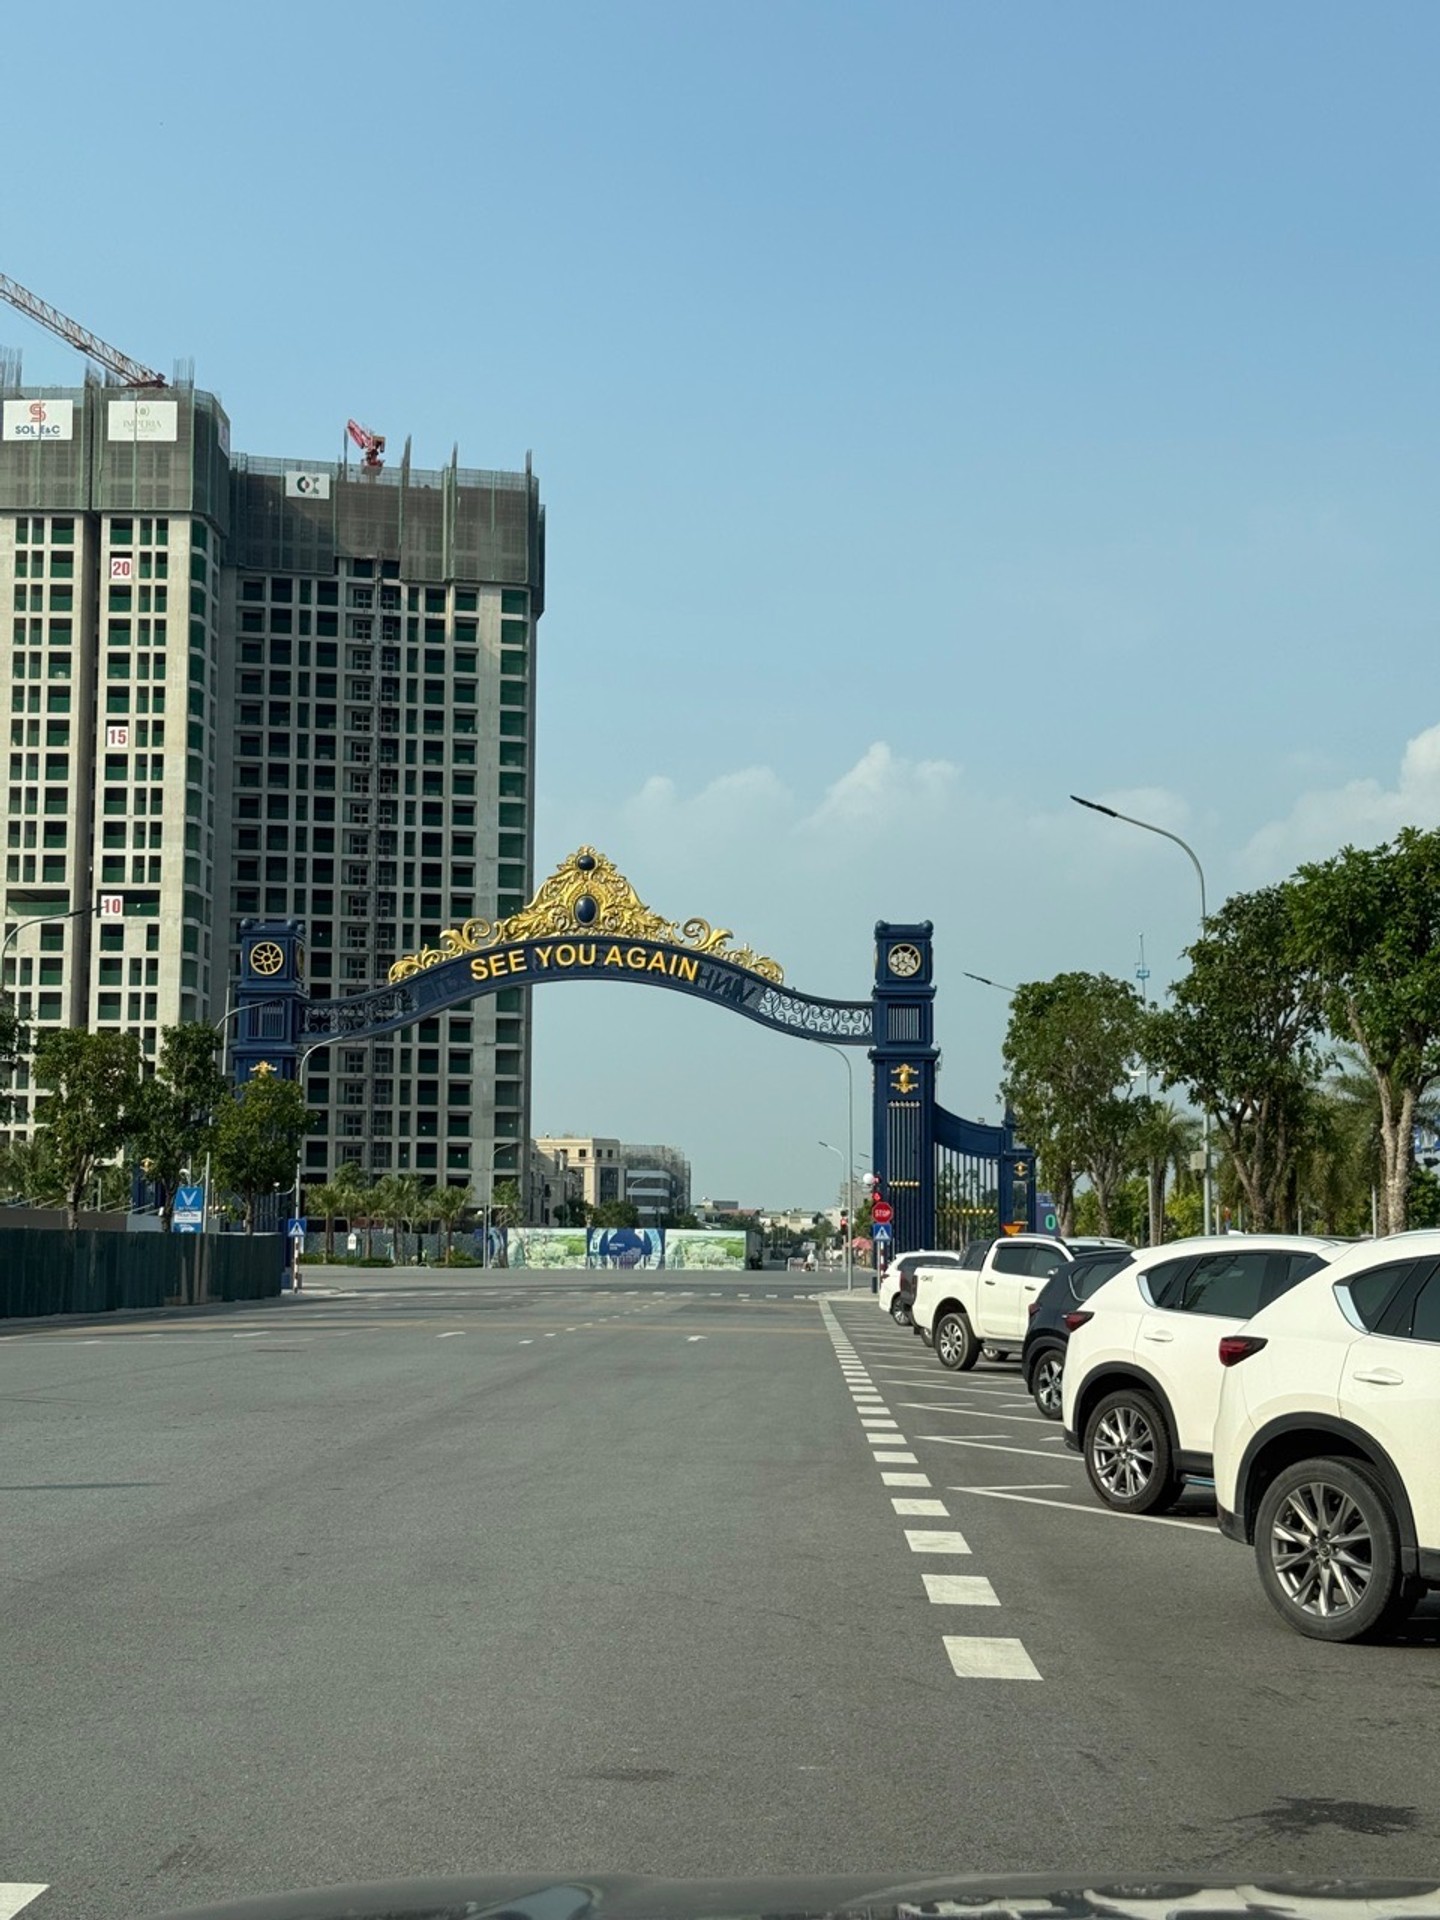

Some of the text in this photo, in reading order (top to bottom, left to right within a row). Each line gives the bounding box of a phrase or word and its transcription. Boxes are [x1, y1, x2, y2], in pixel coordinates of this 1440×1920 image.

[15, 425, 36, 435] SOL
[112, 561, 130, 576] 20
[109, 729, 127, 745] 15
[103, 898, 121, 914] 10
[470, 943, 698, 982] SEE YOU AGAIN
[874, 1208, 891, 1218] STOP
